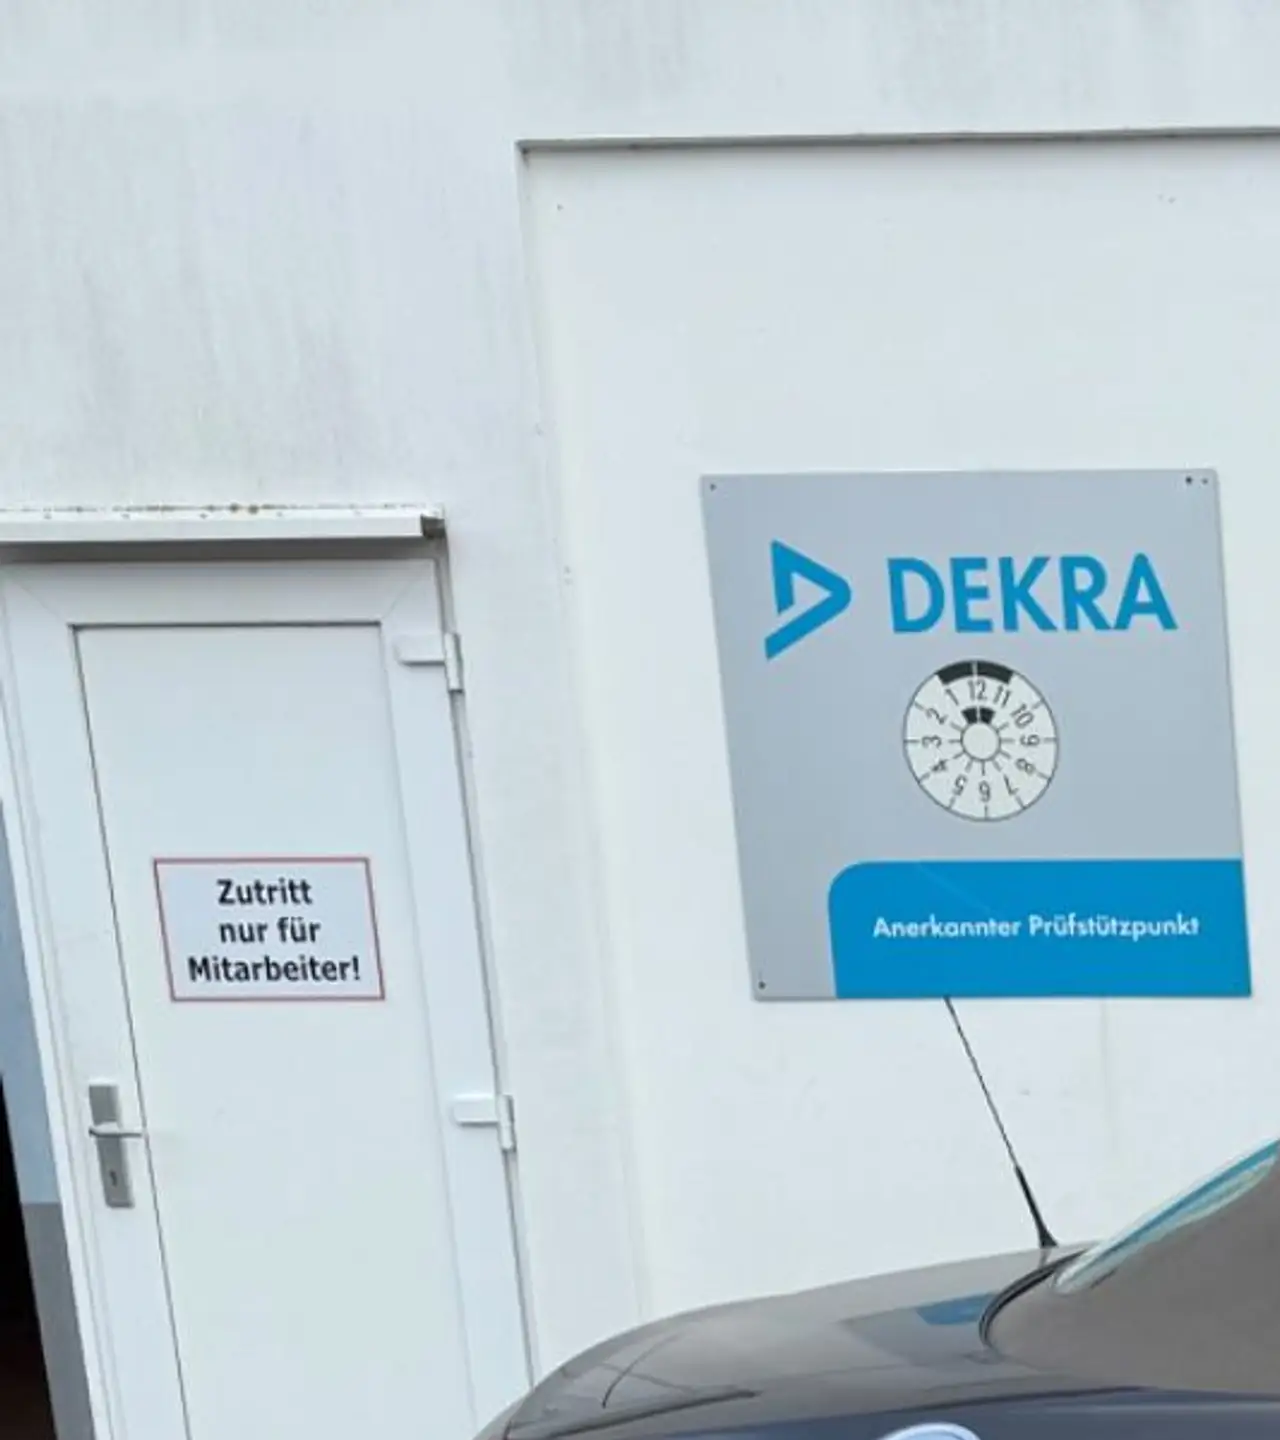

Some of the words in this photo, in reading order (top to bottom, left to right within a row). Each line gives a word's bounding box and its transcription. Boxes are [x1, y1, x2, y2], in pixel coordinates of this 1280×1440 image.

[886, 552, 1178, 634] DEKRA
[968, 679, 987, 700] 12
[993, 686, 1012, 708] 11
[926, 708, 948, 724] 2
[1010, 703, 1034, 728] 10
[921, 735, 942, 748] 3
[1015, 758, 1036, 774] 8
[216, 877, 313, 905] Zutritt
[219, 921, 268, 944] nur
[277, 916, 321, 944] für
[873, 916, 1020, 938] Anerkannter
[1028, 913, 1199, 940] Prüfstützpunkt
[188, 955, 360, 981] Mitarbeiter!
